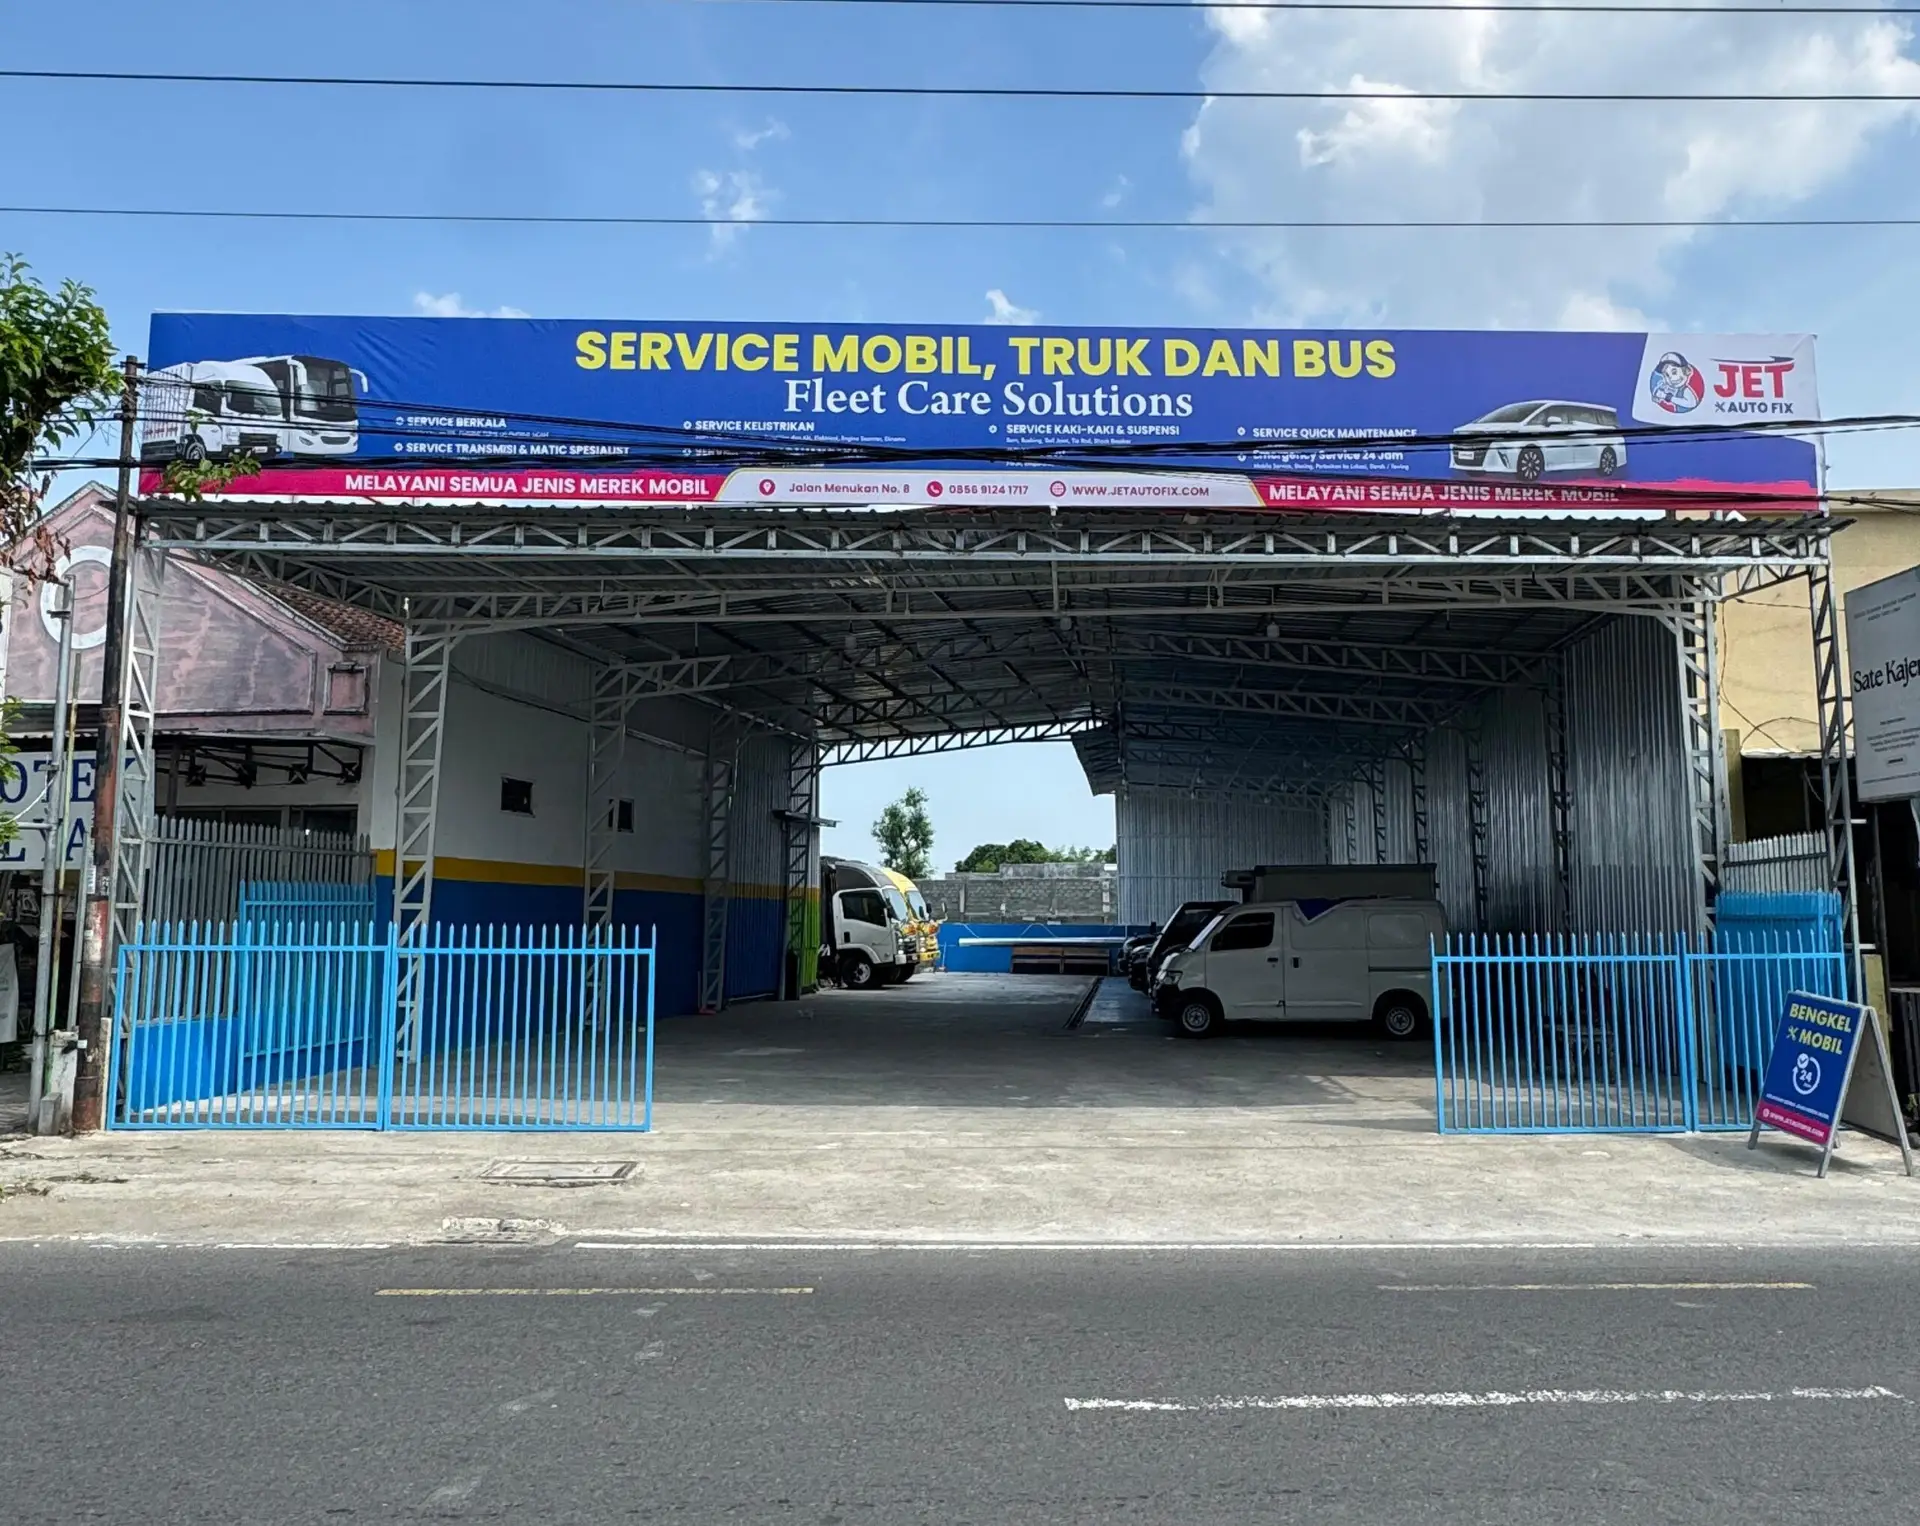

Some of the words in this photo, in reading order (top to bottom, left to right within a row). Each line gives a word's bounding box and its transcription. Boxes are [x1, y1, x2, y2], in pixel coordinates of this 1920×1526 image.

[575, 330, 801, 371] SERVICE
[812, 334, 997, 381] MOBIL,
[1008, 337, 1152, 377] TRUK
[1164, 338, 1281, 379] DAN
[1293, 339, 1397, 379] BUS
[1714, 363, 1795, 398] JET
[784, 379, 887, 415] Fleet
[897, 382, 991, 416] Care
[1003, 381, 1193, 417] Solutions
[1728, 402, 1768, 413] AUTO
[1771, 403, 1794, 414] FIX
[407, 417, 454, 427] SERVICE
[456, 418, 506, 428] BERKALA
[695, 421, 742, 431] SERVICE
[744, 422, 814, 431] KELISTRIKAN
[1006, 425, 1052, 434] SERVICE
[1054, 425, 1114, 435] KAKI-KAKI
[1116, 426, 1124, 435] &
[1127, 426, 1179, 435] SUSPENSI
[1253, 428, 1298, 438] SERVICE
[1300, 428, 1336, 439] QUICK
[1337, 428, 1417, 438] MAINTENANCE
[406, 443, 453, 453] SERVICE
[455, 444, 517, 454] TRANSMISI
[519, 445, 528, 454] &
[530, 445, 567, 454] MATIC
[569, 445, 630, 454] SPESIALIST
[1319, 451, 1360, 460] Service
[1362, 451, 1376, 460] 24
[1378, 452, 1403, 461] Jam
[345, 473, 446, 491] MELAYANI
[450, 475, 517, 493] SEMUA
[521, 477, 575, 495] JENIS
[579, 477, 644, 495] MEREK
[648, 478, 710, 496] MOBIL
[789, 483, 823, 492] Jalan
[825, 484, 880, 493] Menukan
[882, 484, 900, 493] No.
[904, 484, 910, 493] 8
[948, 484, 979, 496] 0856
[980, 484, 1006, 496] 9124
[1008, 484, 1029, 496] 1717
[1072, 486, 1209, 496] WWW.JETAUTOFIX.COM
[1270, 485, 1364, 500] MELAYANI
[1370, 486, 1433, 500] SEMUA
[1440, 486, 1490, 501] JENIS
[1495, 487, 1556, 501] MEREK
[1853, 667, 1883, 693] Sate
[1790, 1004, 1852, 1033] BENGKEL
[1799, 1029, 1843, 1055] MOBIL
[1799, 1070, 1812, 1082] 24
